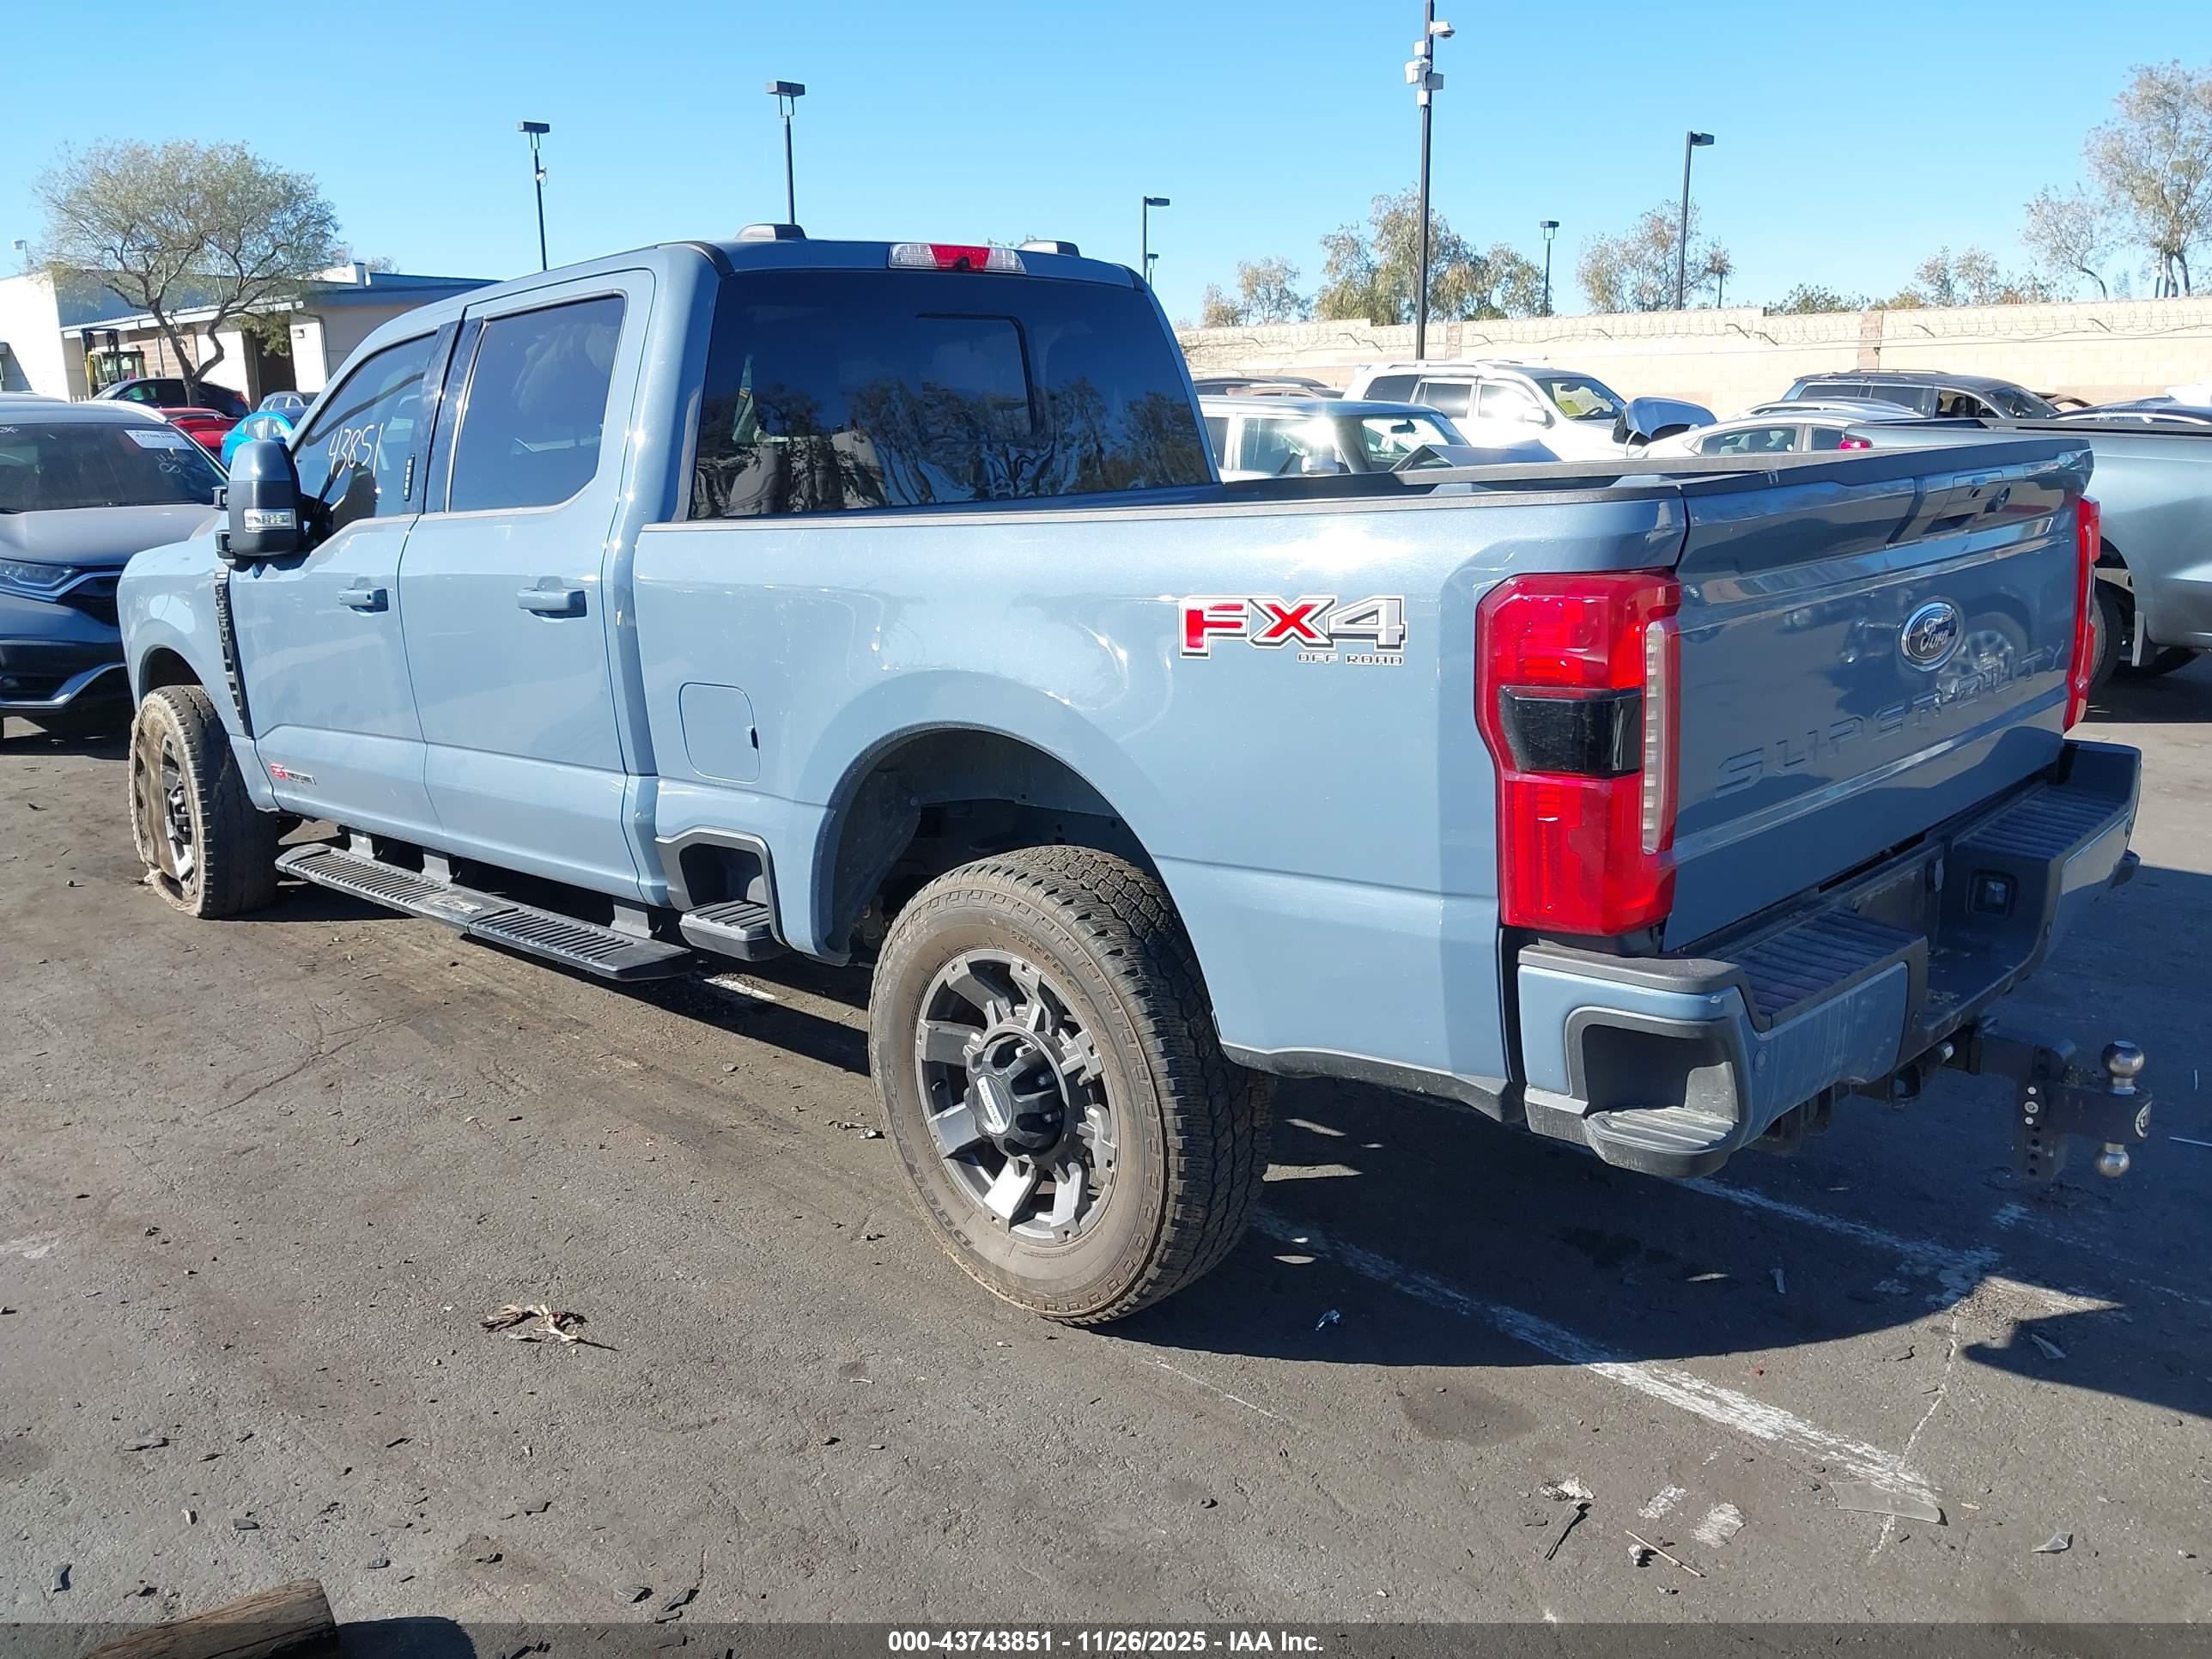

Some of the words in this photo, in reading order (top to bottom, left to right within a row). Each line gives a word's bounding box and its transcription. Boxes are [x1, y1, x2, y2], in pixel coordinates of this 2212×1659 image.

[328, 422, 385, 479] 43851
[1179, 595, 1408, 659] FX4
[1920, 609, 1955, 653] Ford
[1297, 653, 1339, 665] OFF
[1346, 653, 1404, 666] ROAD
[1715, 690, 1943, 799] SUPER
